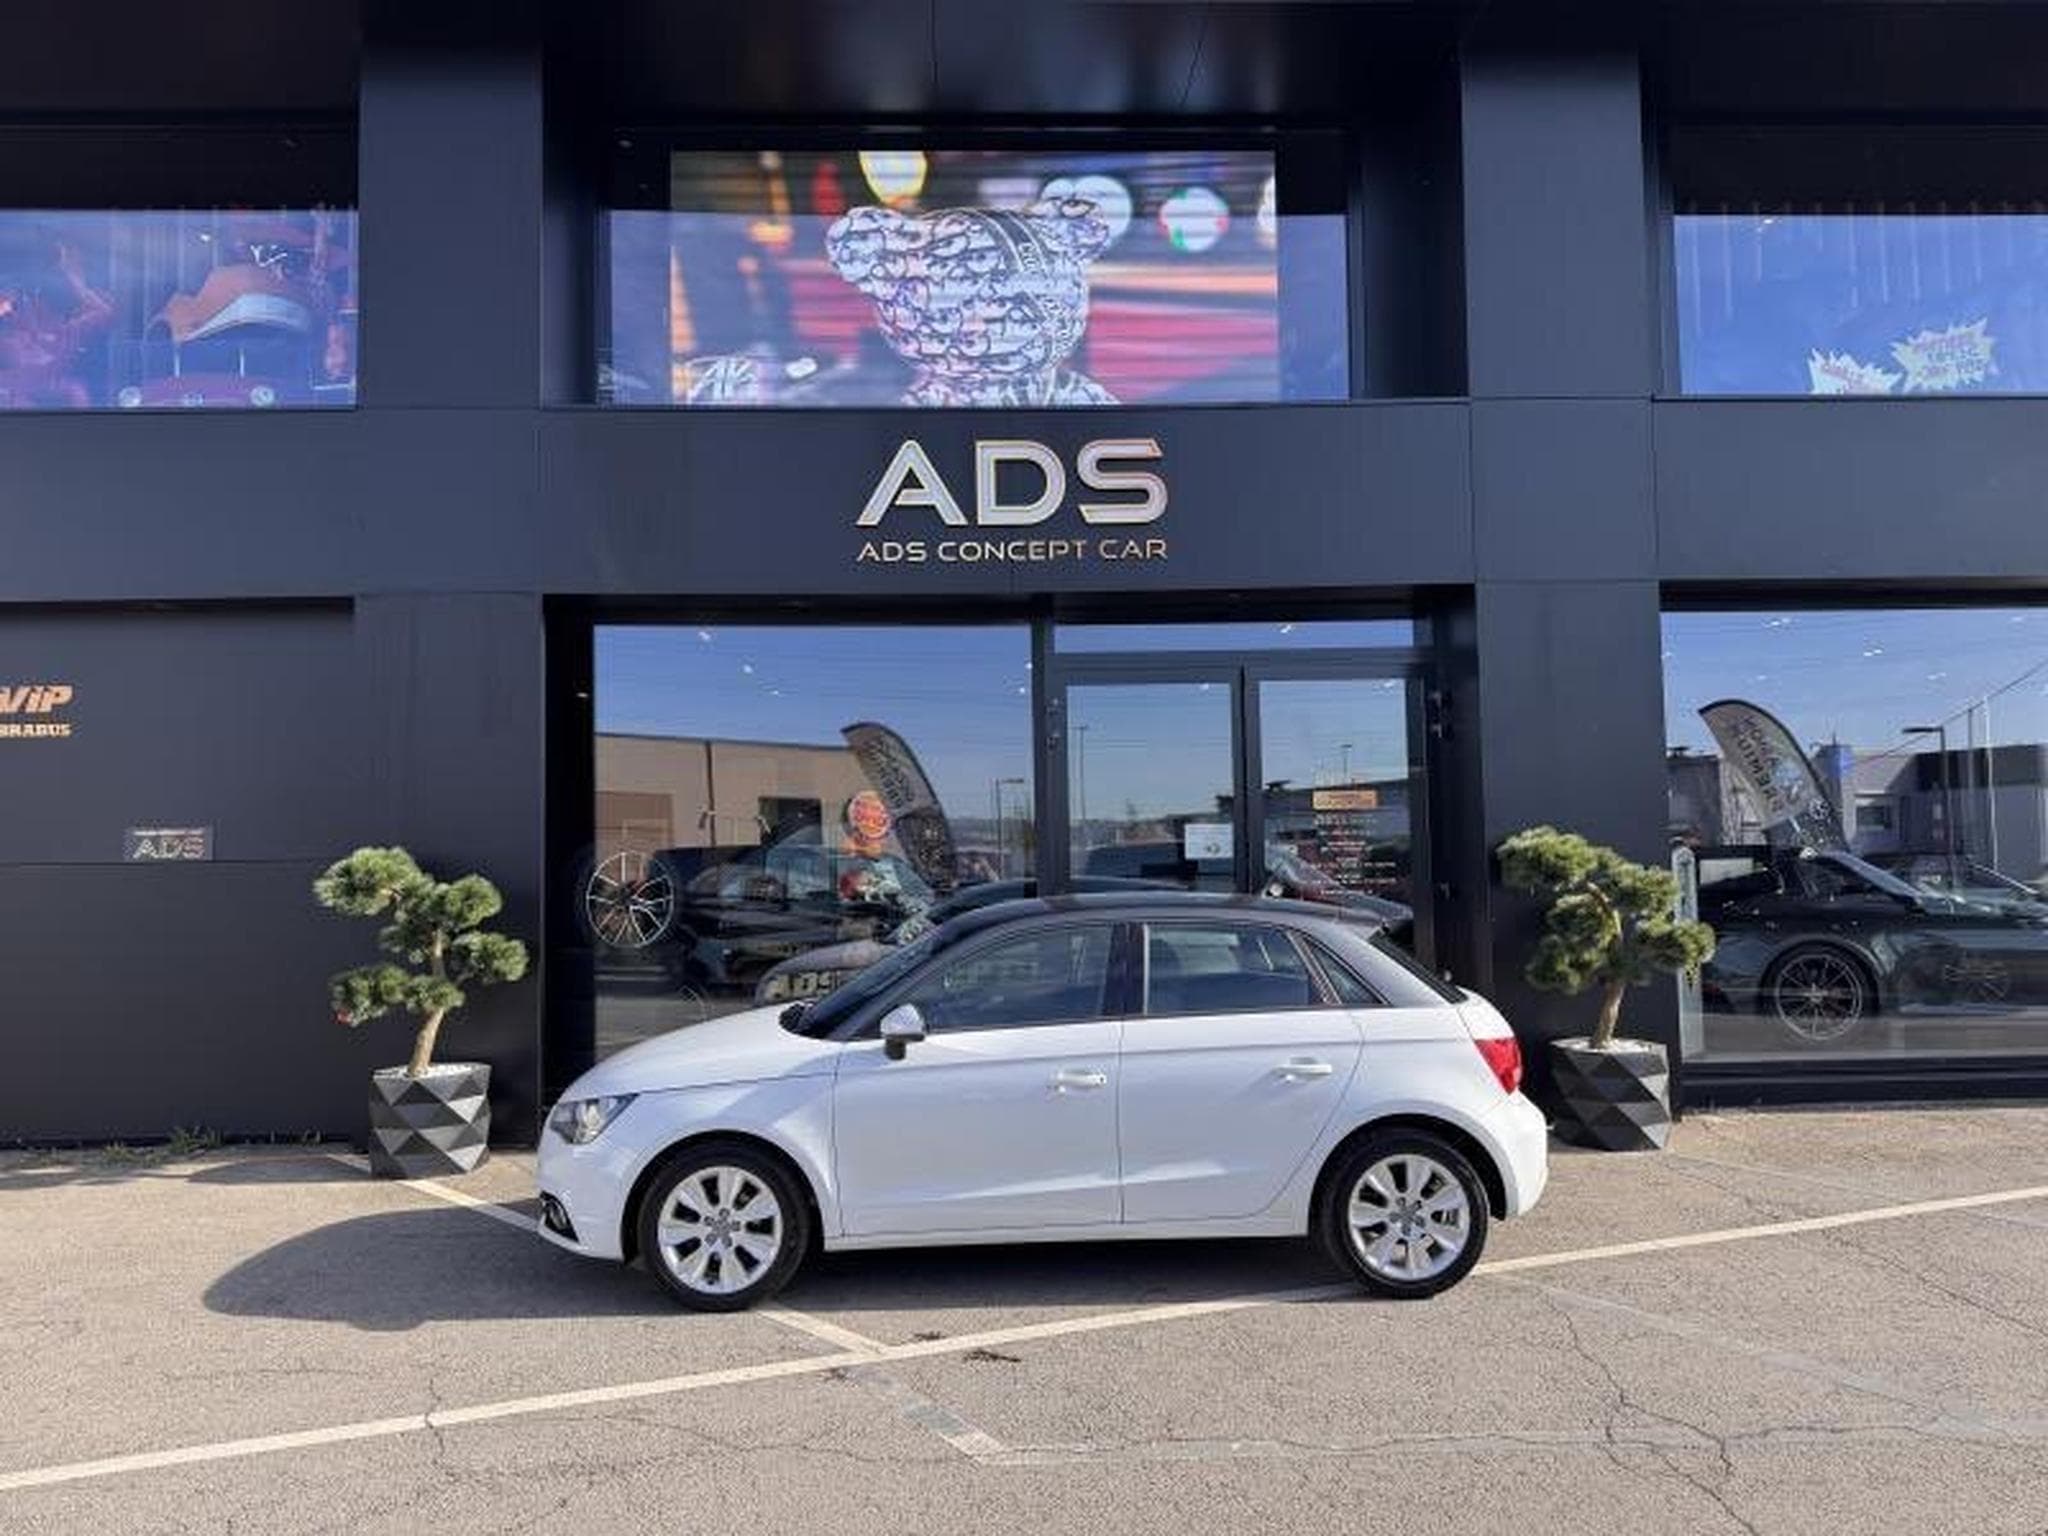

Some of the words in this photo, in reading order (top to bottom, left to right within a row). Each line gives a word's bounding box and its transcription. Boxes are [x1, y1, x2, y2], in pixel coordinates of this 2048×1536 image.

[856, 438, 1168, 526] ADS
[856, 541, 926, 562] ADS
[937, 539, 1087, 561] CONCEPT
[1099, 538, 1168, 560] CAR
